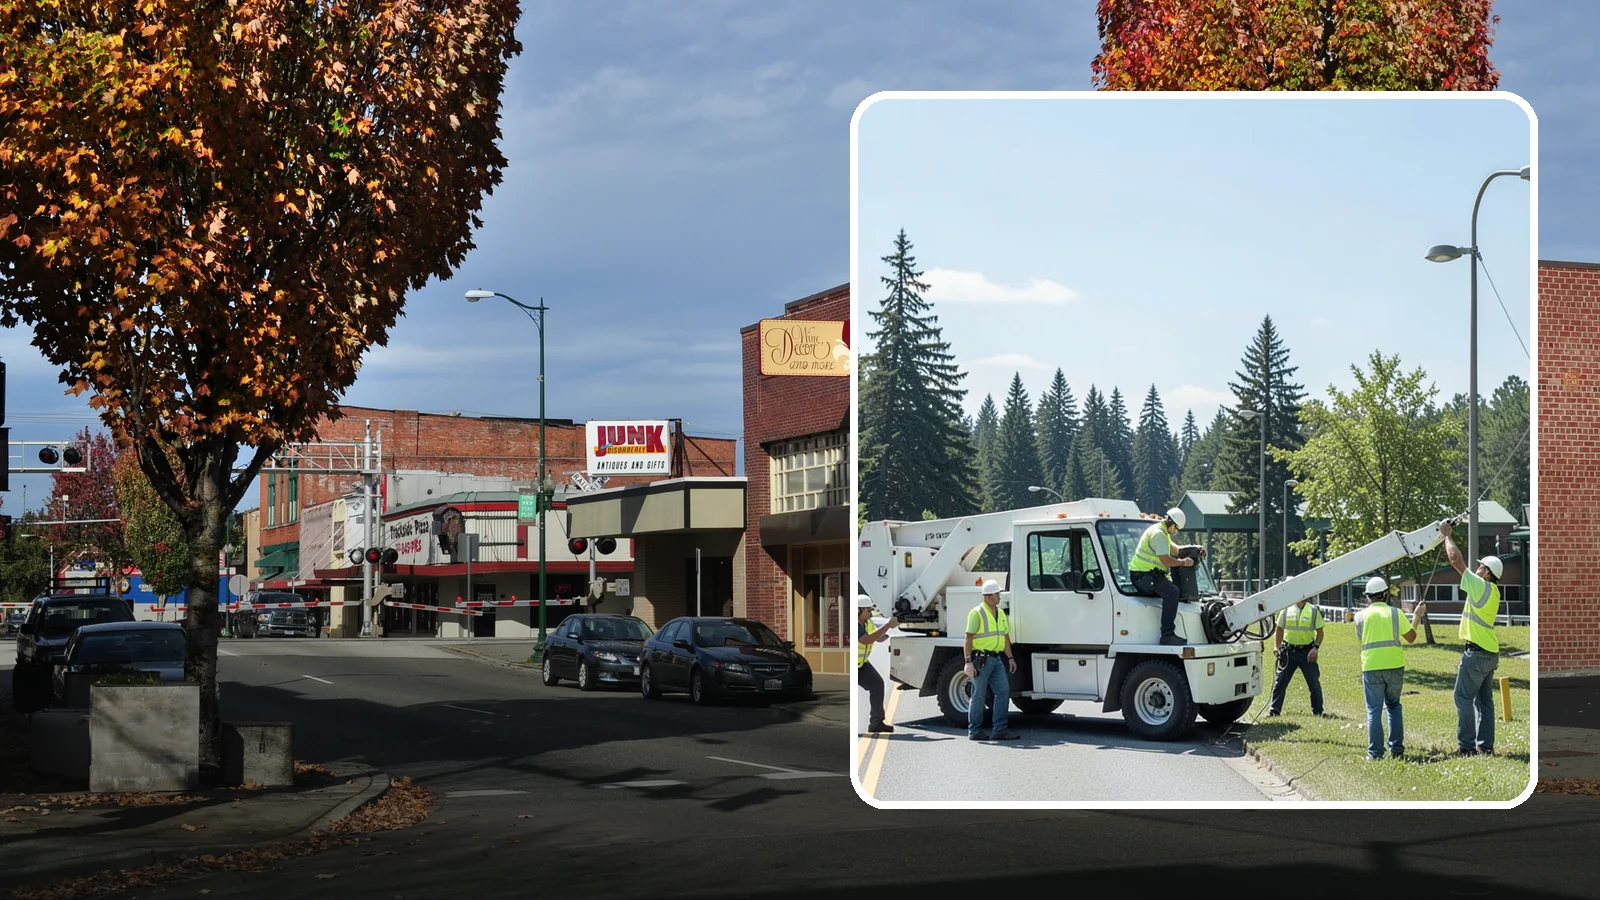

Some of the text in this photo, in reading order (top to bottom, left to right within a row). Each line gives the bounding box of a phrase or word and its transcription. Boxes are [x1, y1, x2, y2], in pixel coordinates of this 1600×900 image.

[595, 425, 665, 457] JUNK
[597, 461, 665, 469] ANTIQUES AND GIFTS
[414, 519, 429, 535] Pizza
